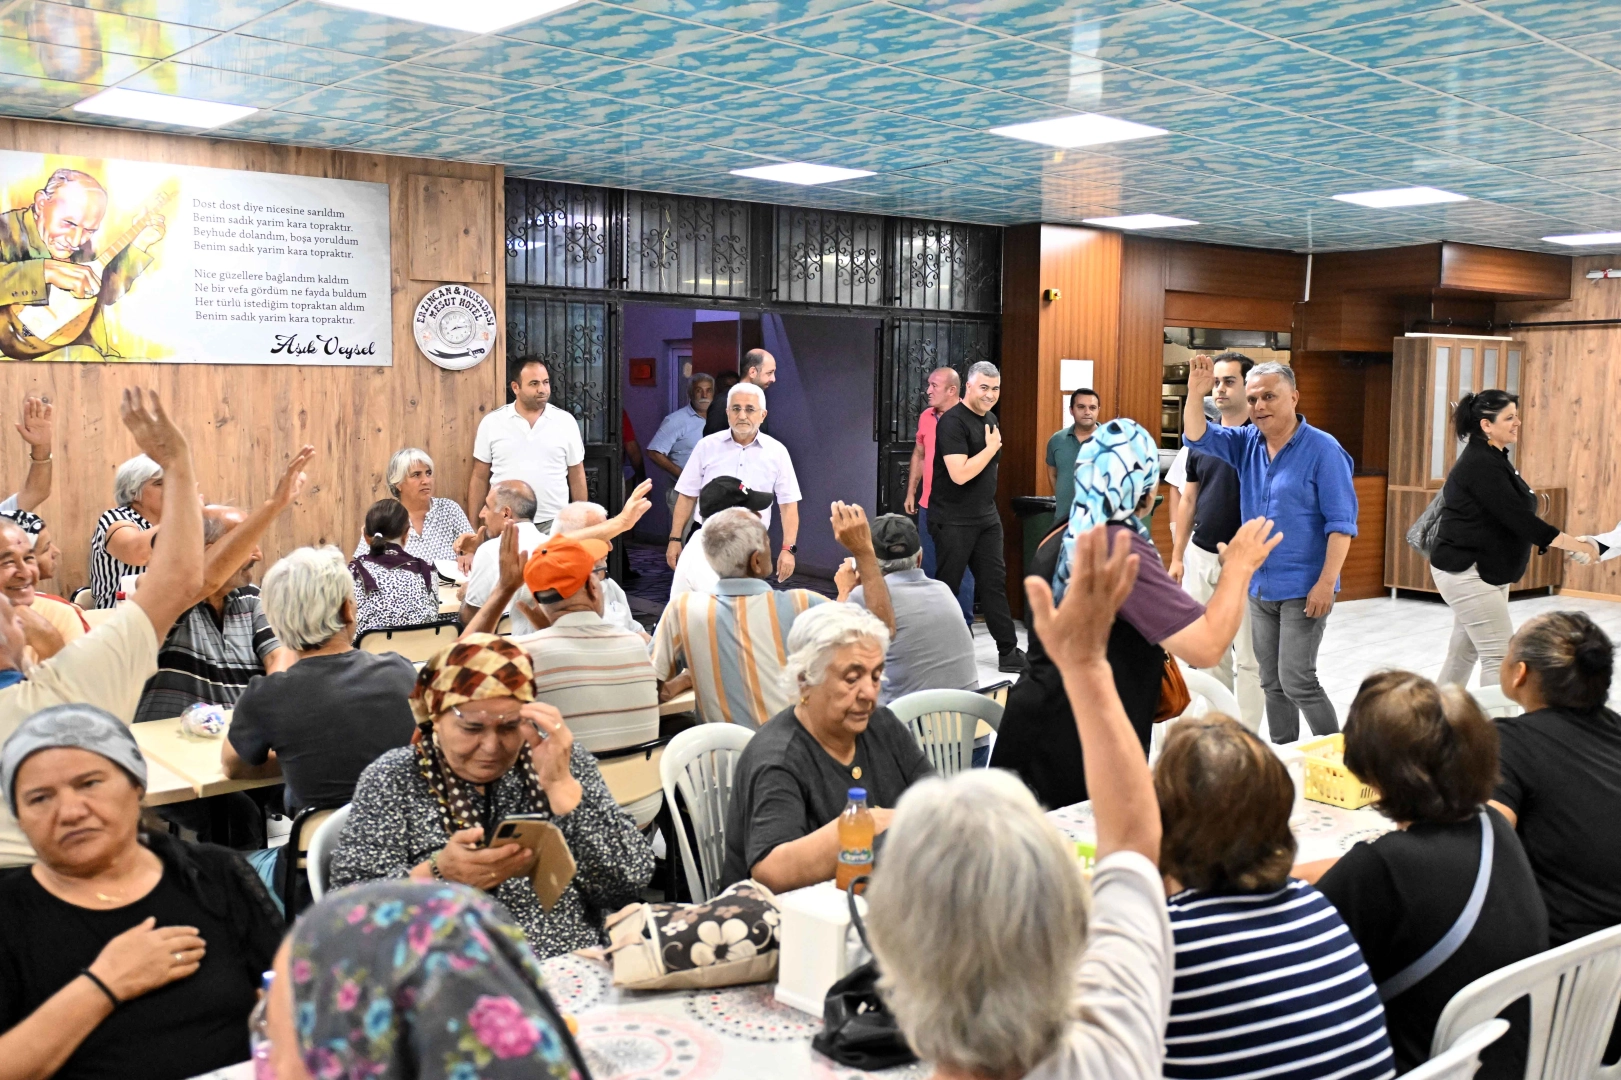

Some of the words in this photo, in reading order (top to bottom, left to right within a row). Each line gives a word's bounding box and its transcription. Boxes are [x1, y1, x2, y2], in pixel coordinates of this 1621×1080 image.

[193, 199, 216, 209] Dost
[220, 201, 241, 211] dost
[244, 202, 263, 213] diye
[266, 205, 304, 215] nicesine
[307, 208, 345, 218] sarıldım
[193, 213, 226, 224] Benim
[228, 216, 254, 225] sadık
[256, 218, 285, 228] yarim
[287, 219, 307, 229] kara
[310, 221, 353, 232] topraktır.
[193, 227, 237, 239] Beyhude
[239, 230, 288, 242] dolandım,
[290, 233, 312, 244] boşa
[314, 235, 359, 246] yoruldum
[194, 241, 226, 252] Benim
[229, 244, 254, 253] sadık
[257, 246, 285, 255] yarim
[287, 247, 308, 256] kara
[310, 249, 354, 259] topraktır.
[194, 269, 216, 279] Nice
[220, 271, 263, 281] güzellere
[266, 272, 315, 283] bağlandım
[318, 275, 349, 284] kaldım
[195, 283, 208, 292] Ne
[211, 284, 225, 293] bir
[228, 285, 248, 294] vefa
[251, 286, 288, 296] gördüm
[291, 288, 302, 296] ne
[305, 287, 330, 298] fayda
[333, 289, 367, 298] buldum
[454, 287, 461, 295] &
[195, 297, 213, 306] Her
[217, 298, 241, 307] türlü
[244, 298, 289, 310] istediğim
[291, 300, 336, 311] topraktan
[340, 302, 365, 312] aldım
[429, 297, 456, 319] MESUT
[459, 298, 483, 321] HOTEL
[195, 311, 227, 321] Benim
[231, 312, 256, 321] sadık
[259, 313, 286, 323] yarim
[289, 314, 309, 323] kara
[312, 315, 355, 325] topraktır.
[317, 334, 376, 359] Veysel
